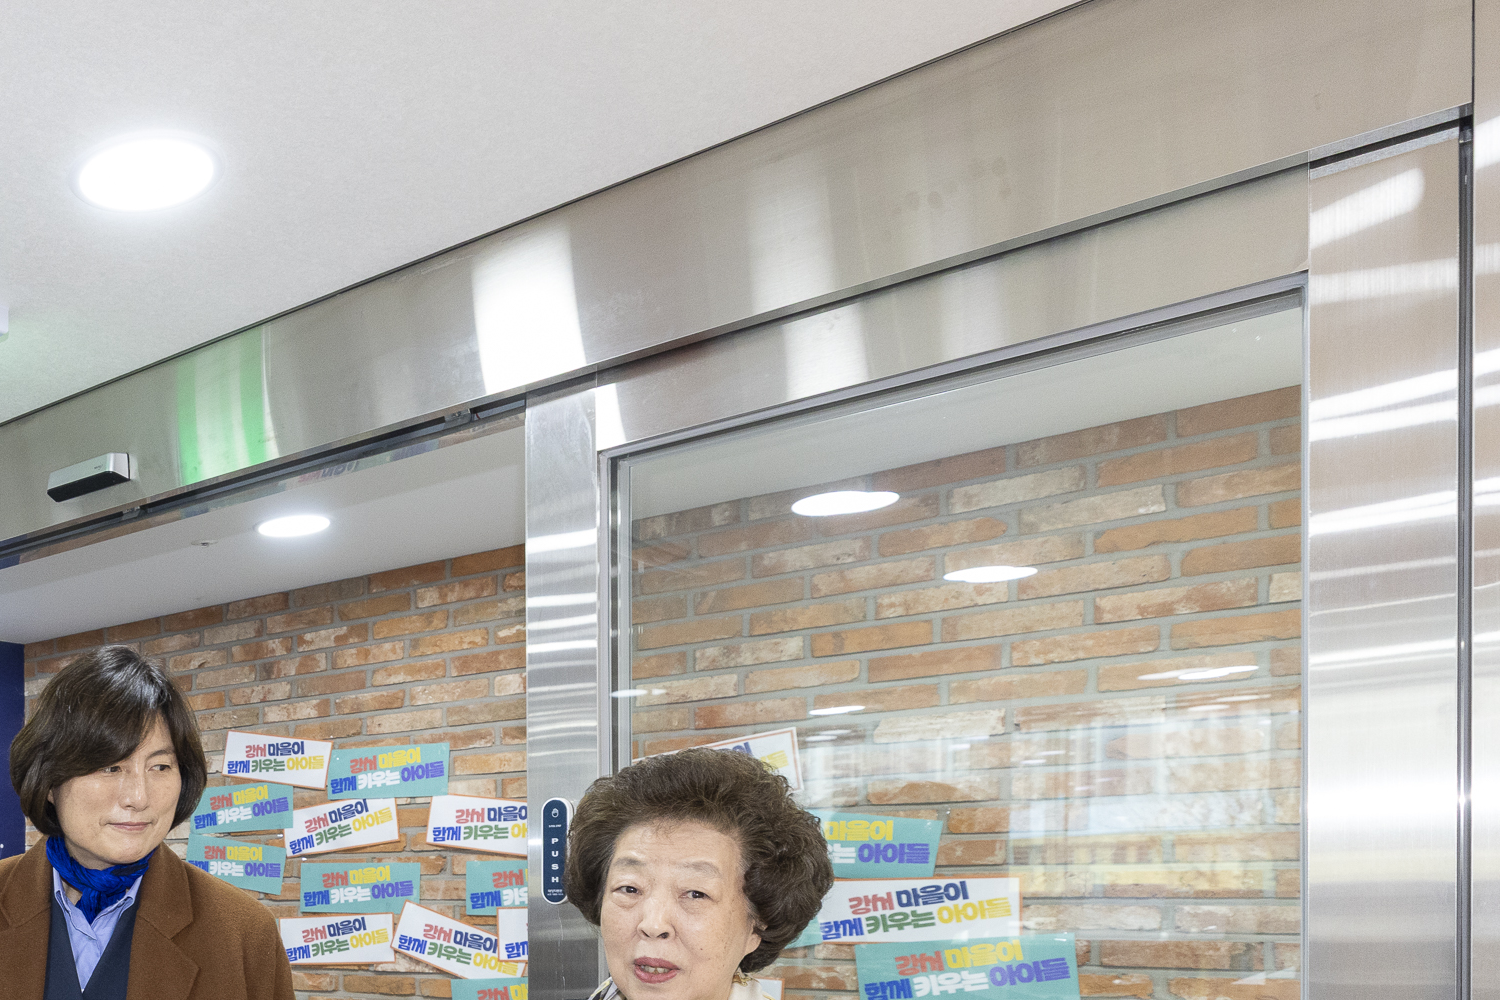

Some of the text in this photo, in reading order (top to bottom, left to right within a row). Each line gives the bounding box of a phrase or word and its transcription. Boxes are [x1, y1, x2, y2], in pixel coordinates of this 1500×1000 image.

[245, 741, 305, 759] 강서 마을이
[350, 747, 420, 774] 강서 마을이
[227, 755, 324, 774] 함께 키우는 아이들
[330, 760, 444, 795] 함께 키우는 아이들
[209, 785, 268, 810] 강서 마을이
[194, 796, 289, 829] 함께 키우는 아이들
[304, 799, 369, 833] 강서 마을이
[456, 808, 485, 824] 강서
[289, 807, 393, 855] 함께 키우는 아이들
[433, 826, 461, 842] 함께
[463, 825, 509, 840] 키우는
[204, 844, 263, 861] 강서 마을이
[551, 838, 559, 883] PUSH
[857, 842, 929, 864] 아이들
[209, 860, 244, 876] 키우는
[244, 862, 281, 878] 아이들
[322, 866, 390, 888] 강서 마을이
[492, 869, 524, 888] 강서
[303, 880, 413, 907] 함께 키우는 아이들
[470, 890, 501, 909] 함께
[848, 881, 970, 915] 강서 마을이
[302, 917, 366, 942] 강서 마을이
[821, 898, 1011, 941] 함께 키우는 아이들
[285, 930, 389, 962] 함께 키우는 아이들
[398, 934, 428, 954] 함께
[427, 942, 472, 965] 키우는
[423, 923, 498, 953] 강서 마을이
[895, 940, 1025, 976] 강서 마을이
[913, 969, 989, 998] 키우는
[990, 958, 1070, 987] 아이들
